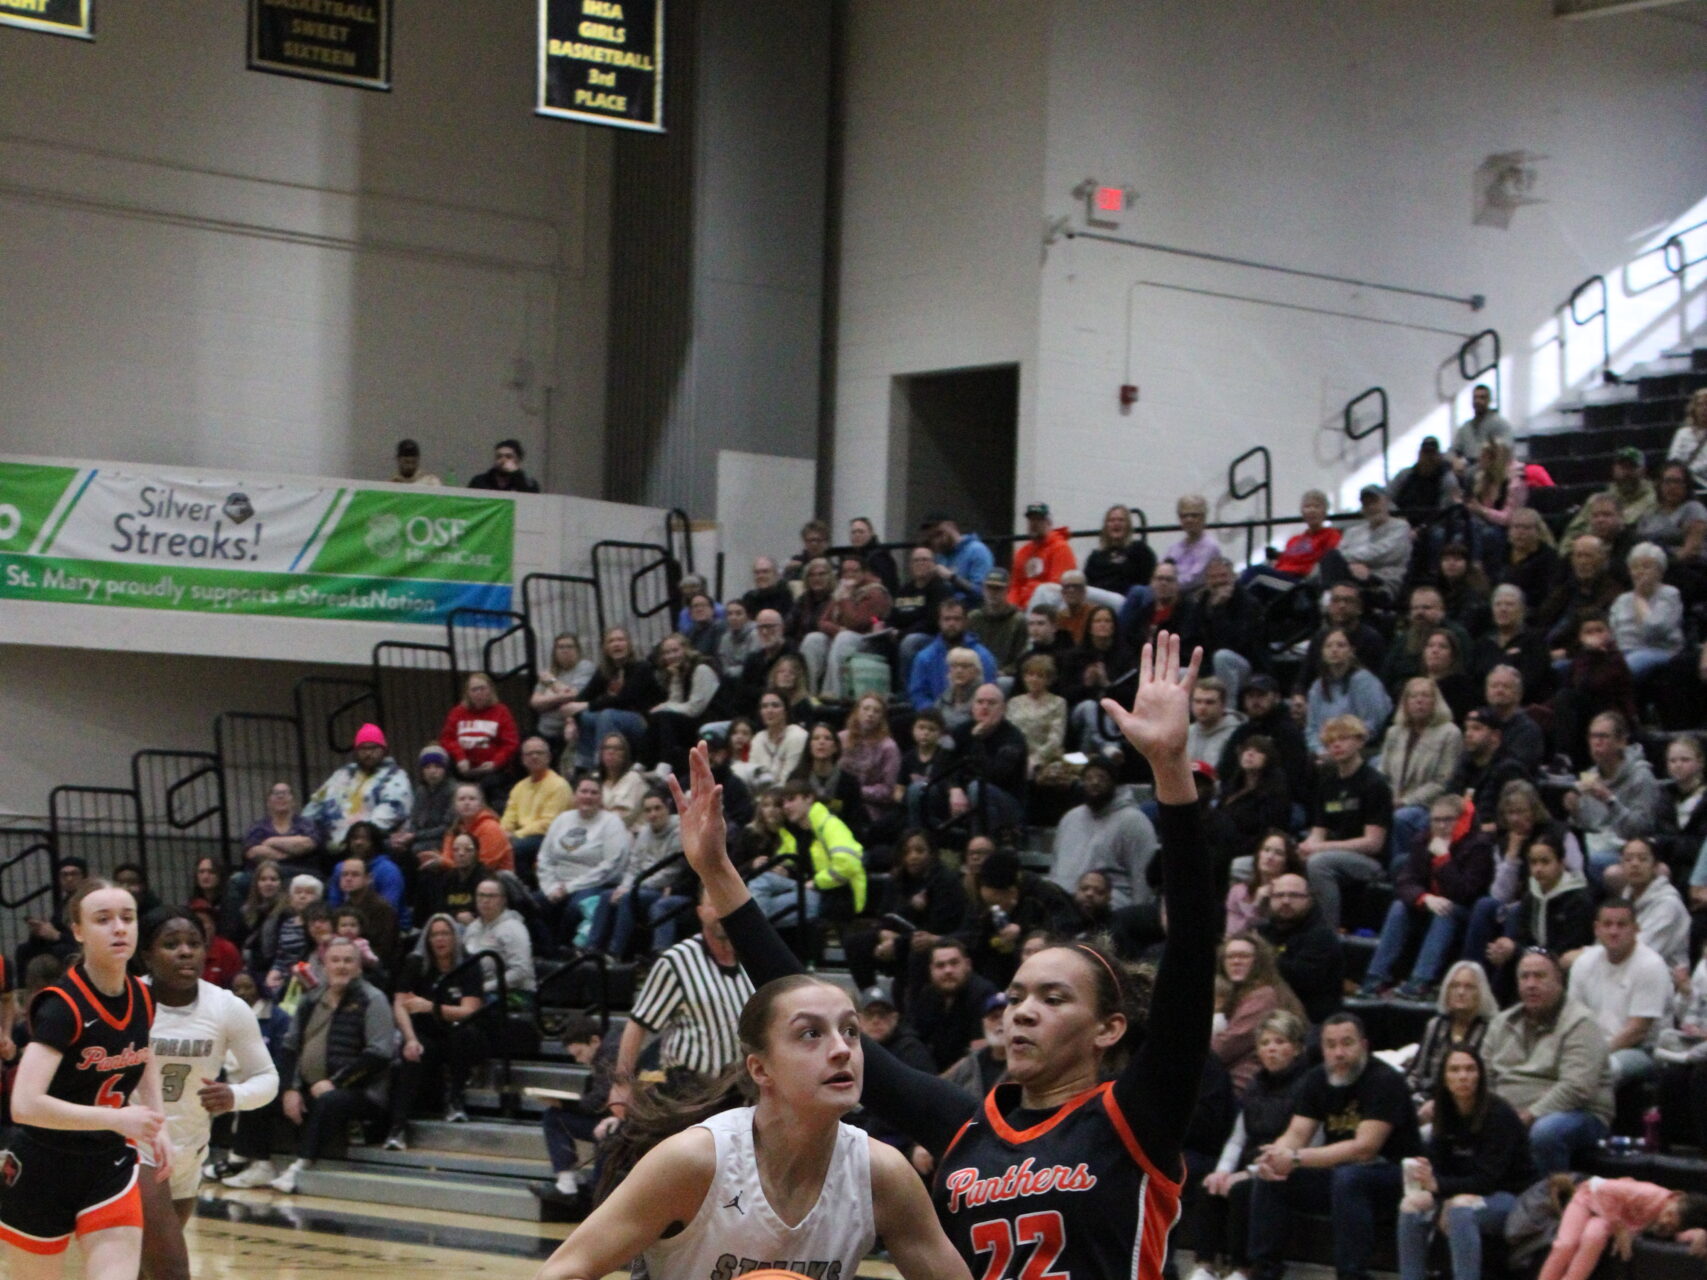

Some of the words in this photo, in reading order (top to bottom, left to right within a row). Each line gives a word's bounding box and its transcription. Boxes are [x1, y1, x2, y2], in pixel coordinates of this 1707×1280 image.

[292, 18, 350, 41] SWEET
[578, 21, 626, 43] GIRLS
[283, 41, 356, 67] SIXTEEN
[548, 39, 655, 71] BASKETBALL
[575, 89, 627, 111] PLACE
[138, 486, 216, 521] Silver
[111, 513, 262, 562] Streaks!
[406, 516, 468, 547] OSF
[7, 564, 37, 588] St.
[43, 567, 100, 600] Mary
[106, 576, 184, 605] proudly
[191, 583, 279, 610] supports
[95, 1073, 125, 1109] 6
[162, 1063, 192, 1102] 3
[946, 1157, 1097, 1213] Panthers
